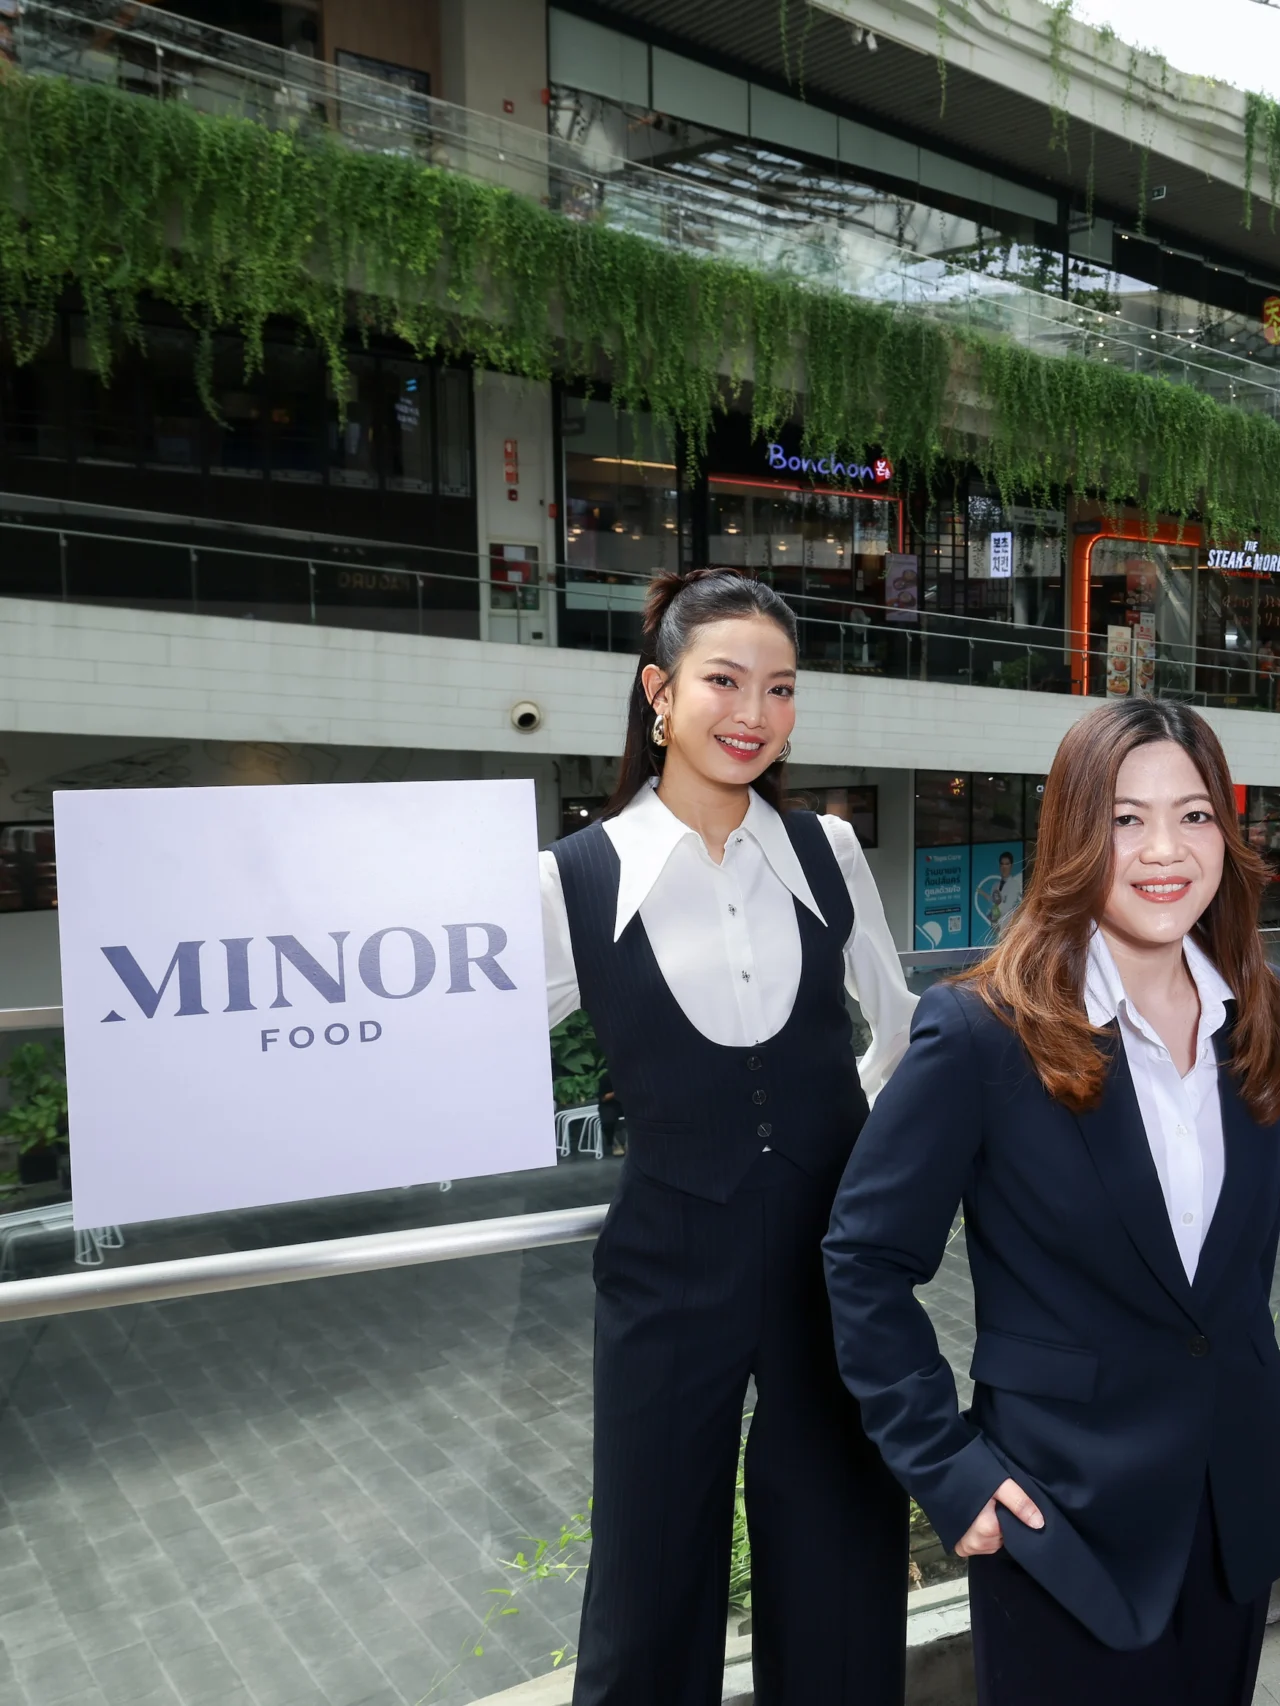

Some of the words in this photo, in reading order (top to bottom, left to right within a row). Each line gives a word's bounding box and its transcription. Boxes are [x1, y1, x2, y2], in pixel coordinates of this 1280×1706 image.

[768, 443, 875, 480] Bonchon
[1207, 549, 1245, 569] STEAK
[1244, 556, 1252, 568] &
[1244, 540, 1258, 552] THE
[101, 923, 518, 1022] MINOR
[261, 1020, 382, 1051] FOOD
